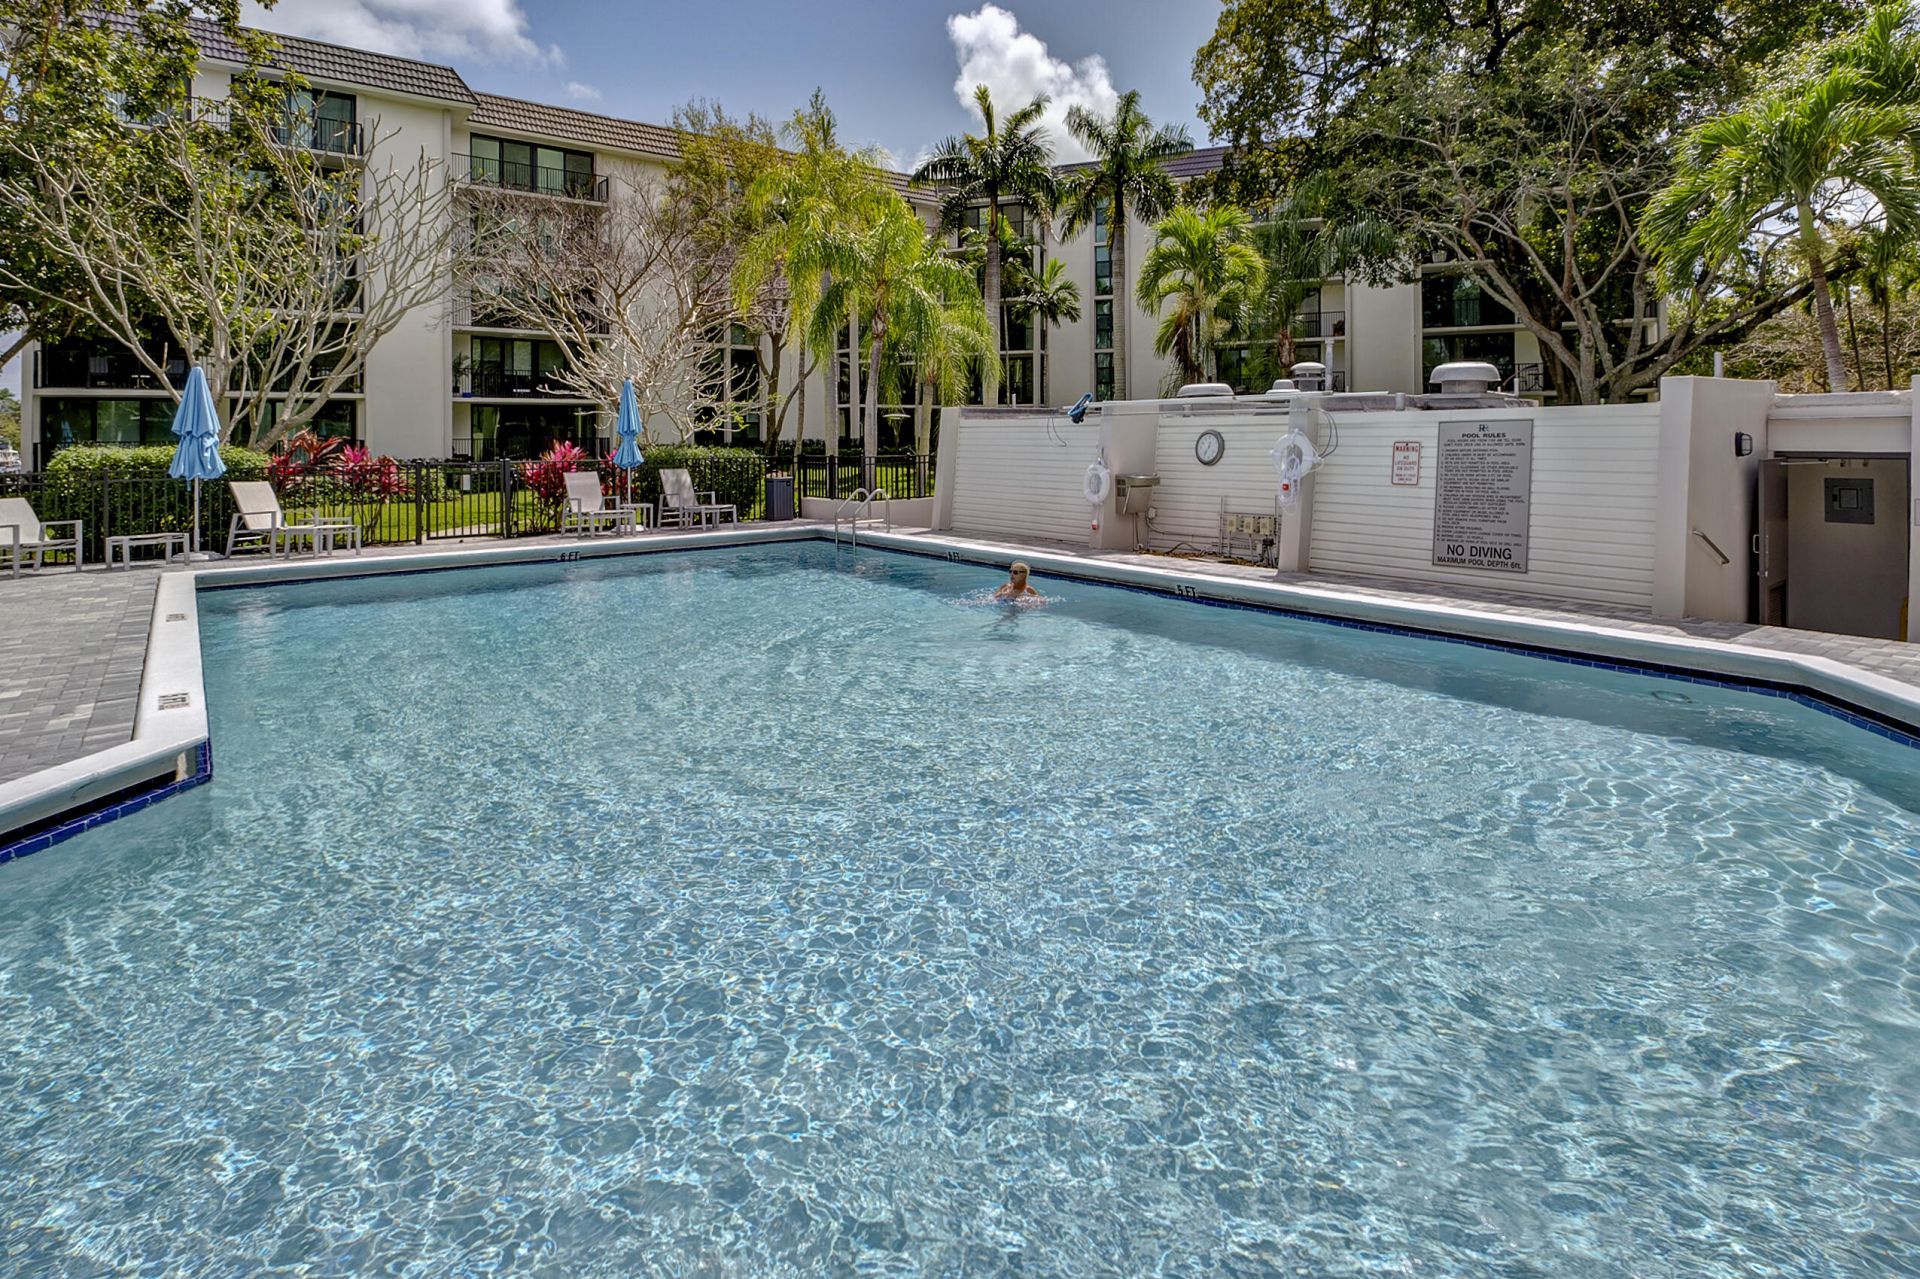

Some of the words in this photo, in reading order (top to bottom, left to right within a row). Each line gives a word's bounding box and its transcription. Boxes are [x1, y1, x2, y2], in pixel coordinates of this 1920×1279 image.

[569, 551, 580, 560] FT
[1447, 544, 1464, 556] NO
[1470, 546, 1512, 560] DIVING
[1437, 556, 1466, 564] MAXIMUM
[1468, 558, 1485, 567] POOL
[1487, 560, 1509, 568] DEPTH
[1185, 586, 1196, 598] FT
